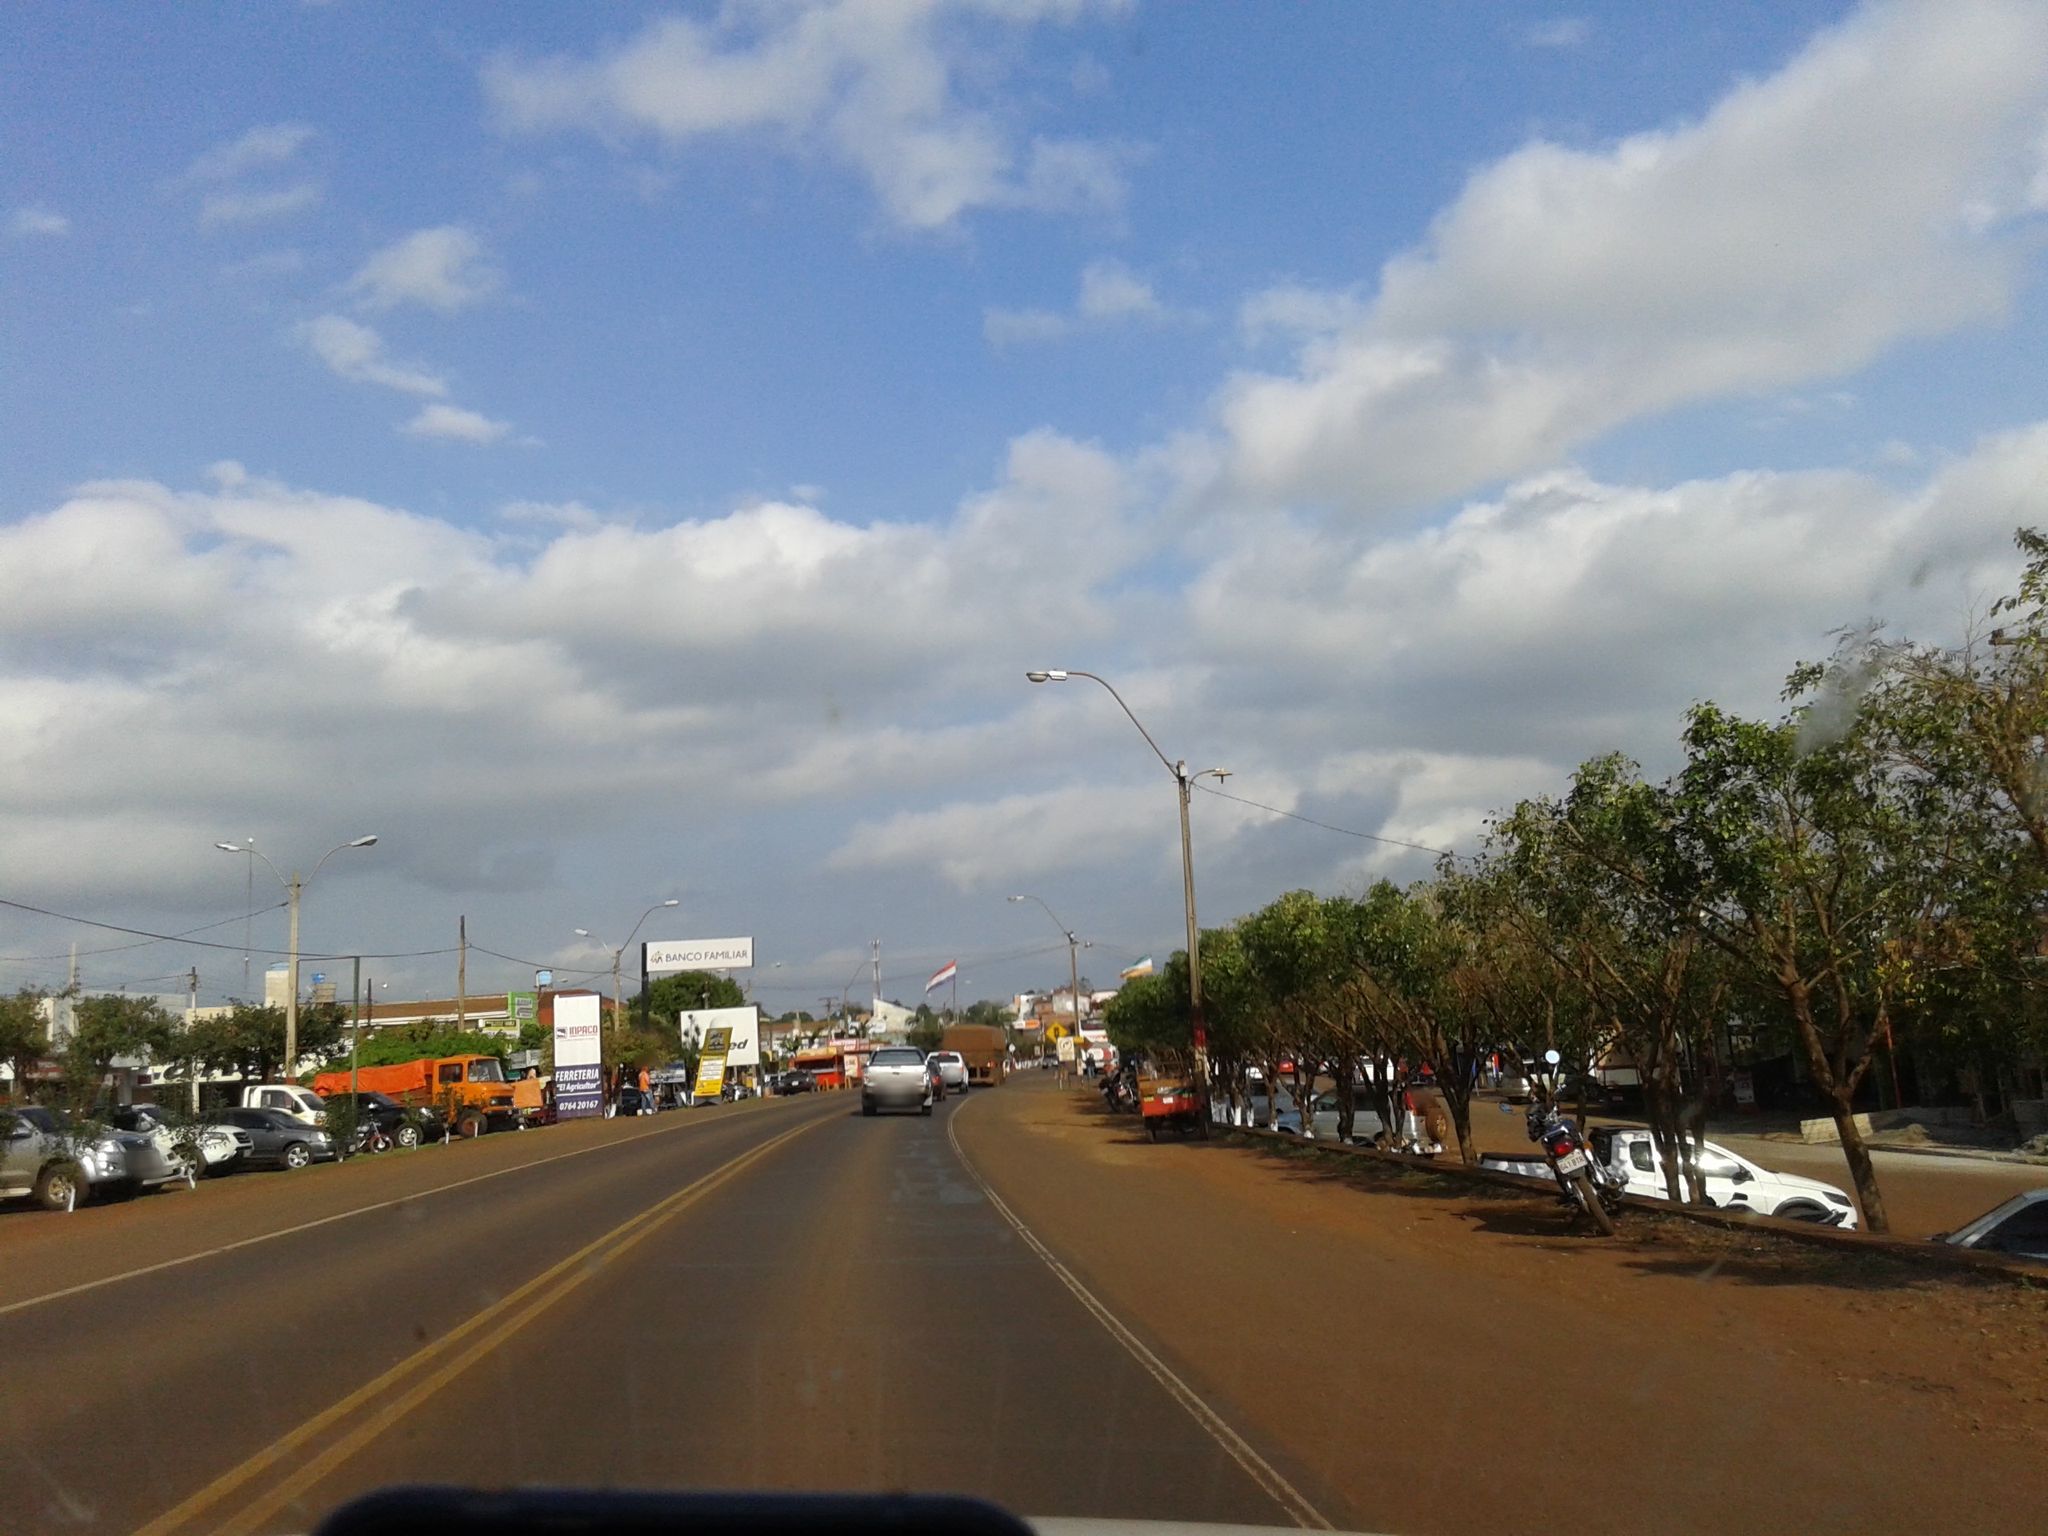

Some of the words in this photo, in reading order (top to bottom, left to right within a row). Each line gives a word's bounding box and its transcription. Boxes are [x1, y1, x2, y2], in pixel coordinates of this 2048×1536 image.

[665, 952, 702, 962] BANCO
[704, 949, 748, 960] FAMILIAR
[555, 1069, 599, 1081] FERRETERIA
[559, 1102, 577, 1111] 0764
[577, 1100, 599, 1110] 20167
